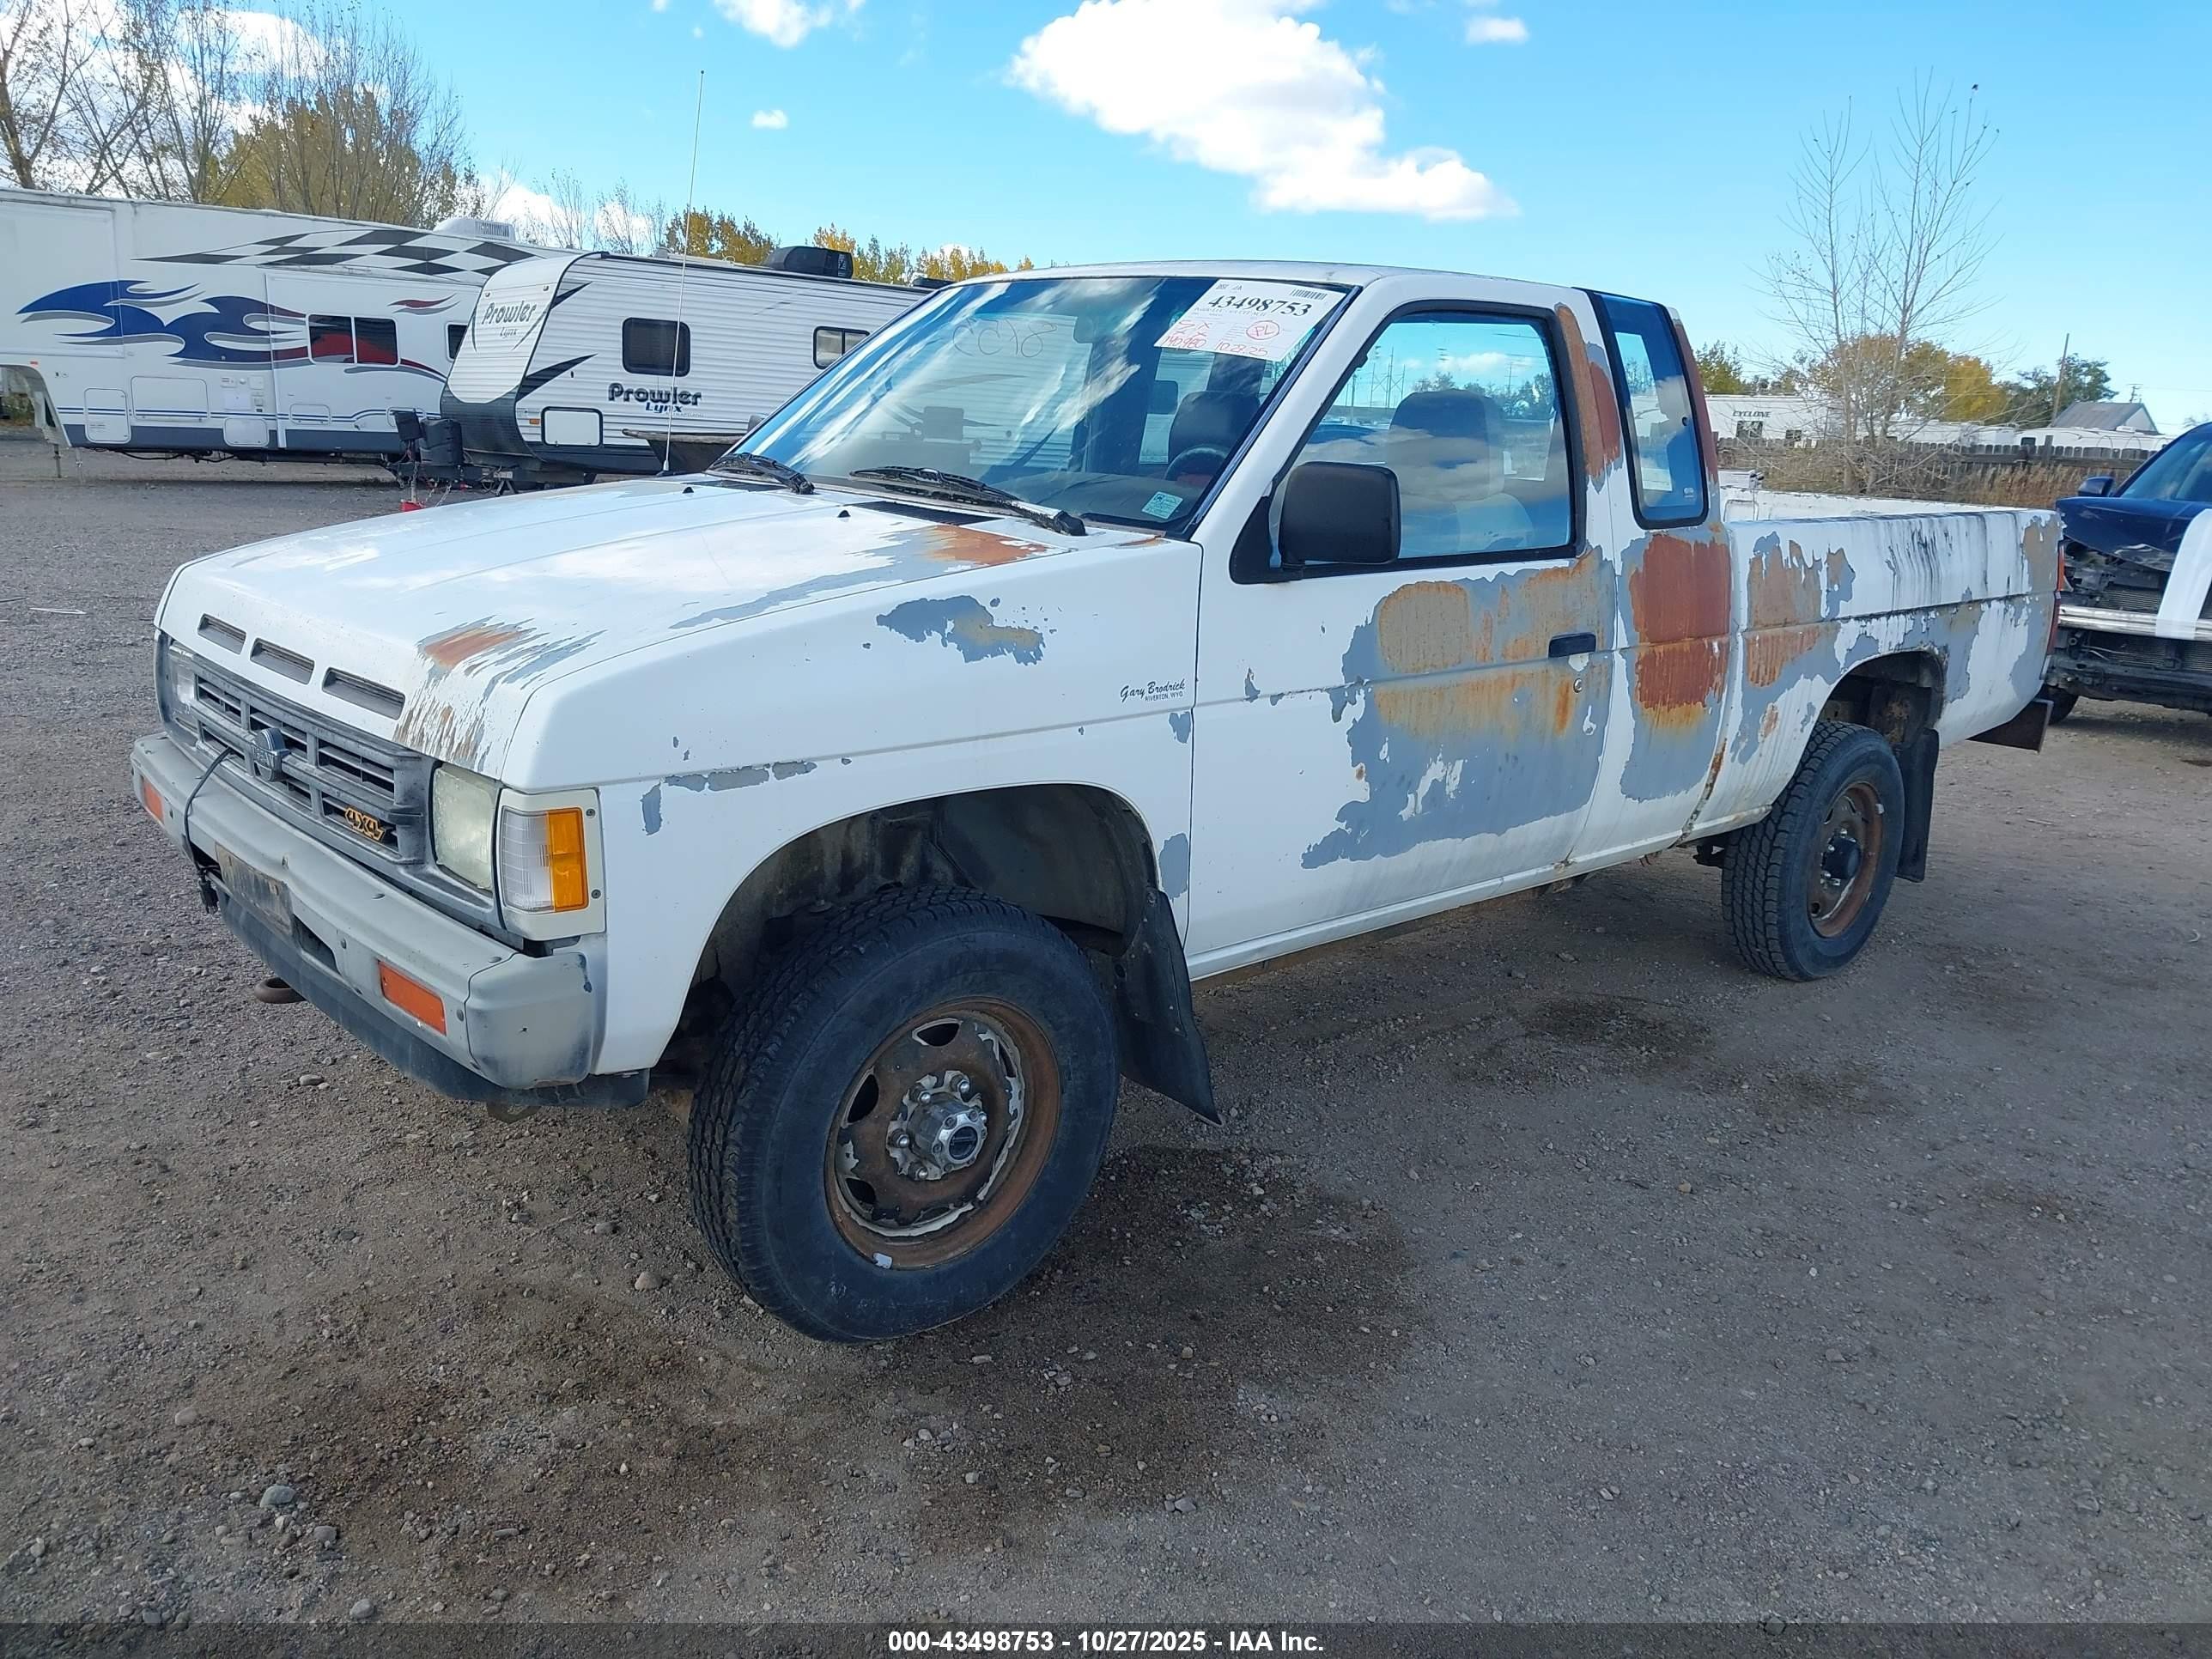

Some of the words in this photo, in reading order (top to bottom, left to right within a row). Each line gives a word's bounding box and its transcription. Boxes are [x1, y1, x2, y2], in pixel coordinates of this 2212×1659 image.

[481, 301, 538, 325] Prowler
[1207, 295, 1313, 317] 43498753
[608, 382, 702, 406] Prowler
[645, 402, 684, 414] Lynx
[1120, 685, 1146, 702] Gary
[1147, 678, 1185, 695] Brodrick
